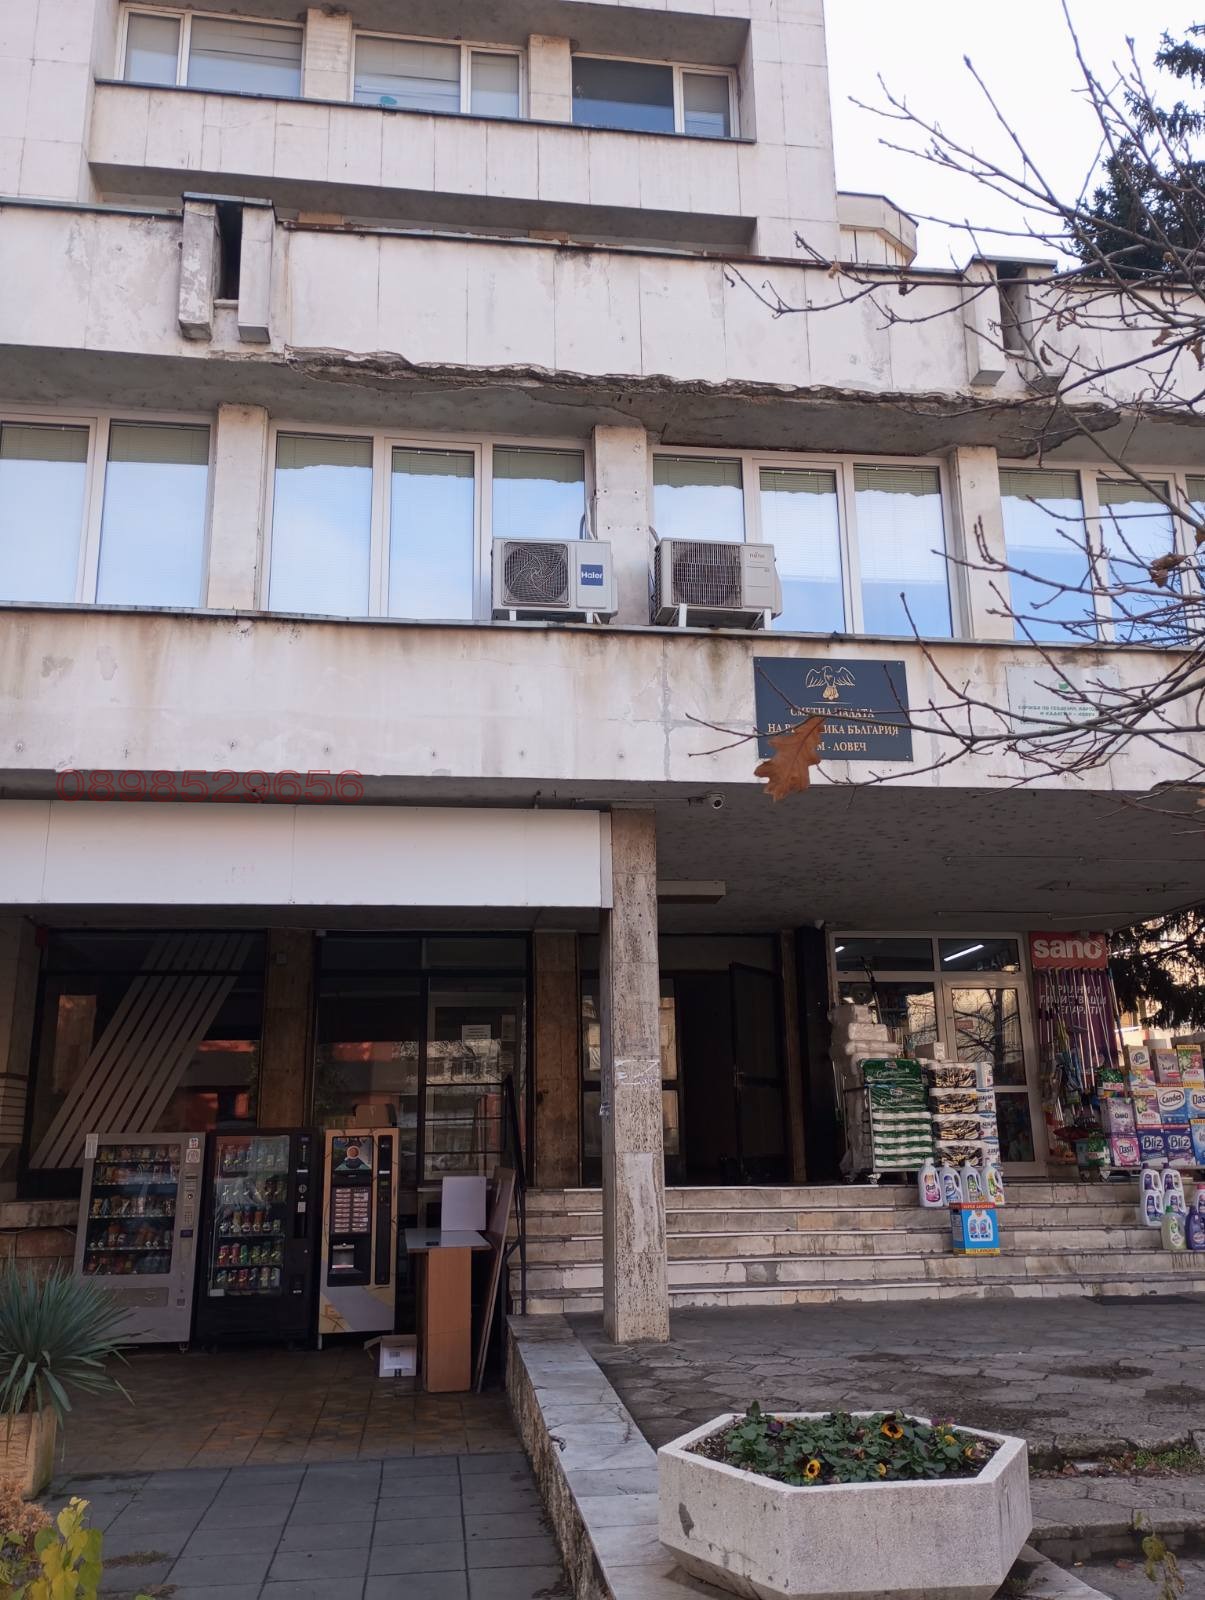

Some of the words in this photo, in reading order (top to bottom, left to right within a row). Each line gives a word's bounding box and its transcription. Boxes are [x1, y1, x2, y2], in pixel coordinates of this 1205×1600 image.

[581, 570, 603, 580] Haier
[768, 723, 782, 734] НА
[847, 725, 899, 737] БЪЛГАРИЯ
[832, 741, 867, 752] ЛОВЕЧ
[1033, 939, 1103, 960] sano
